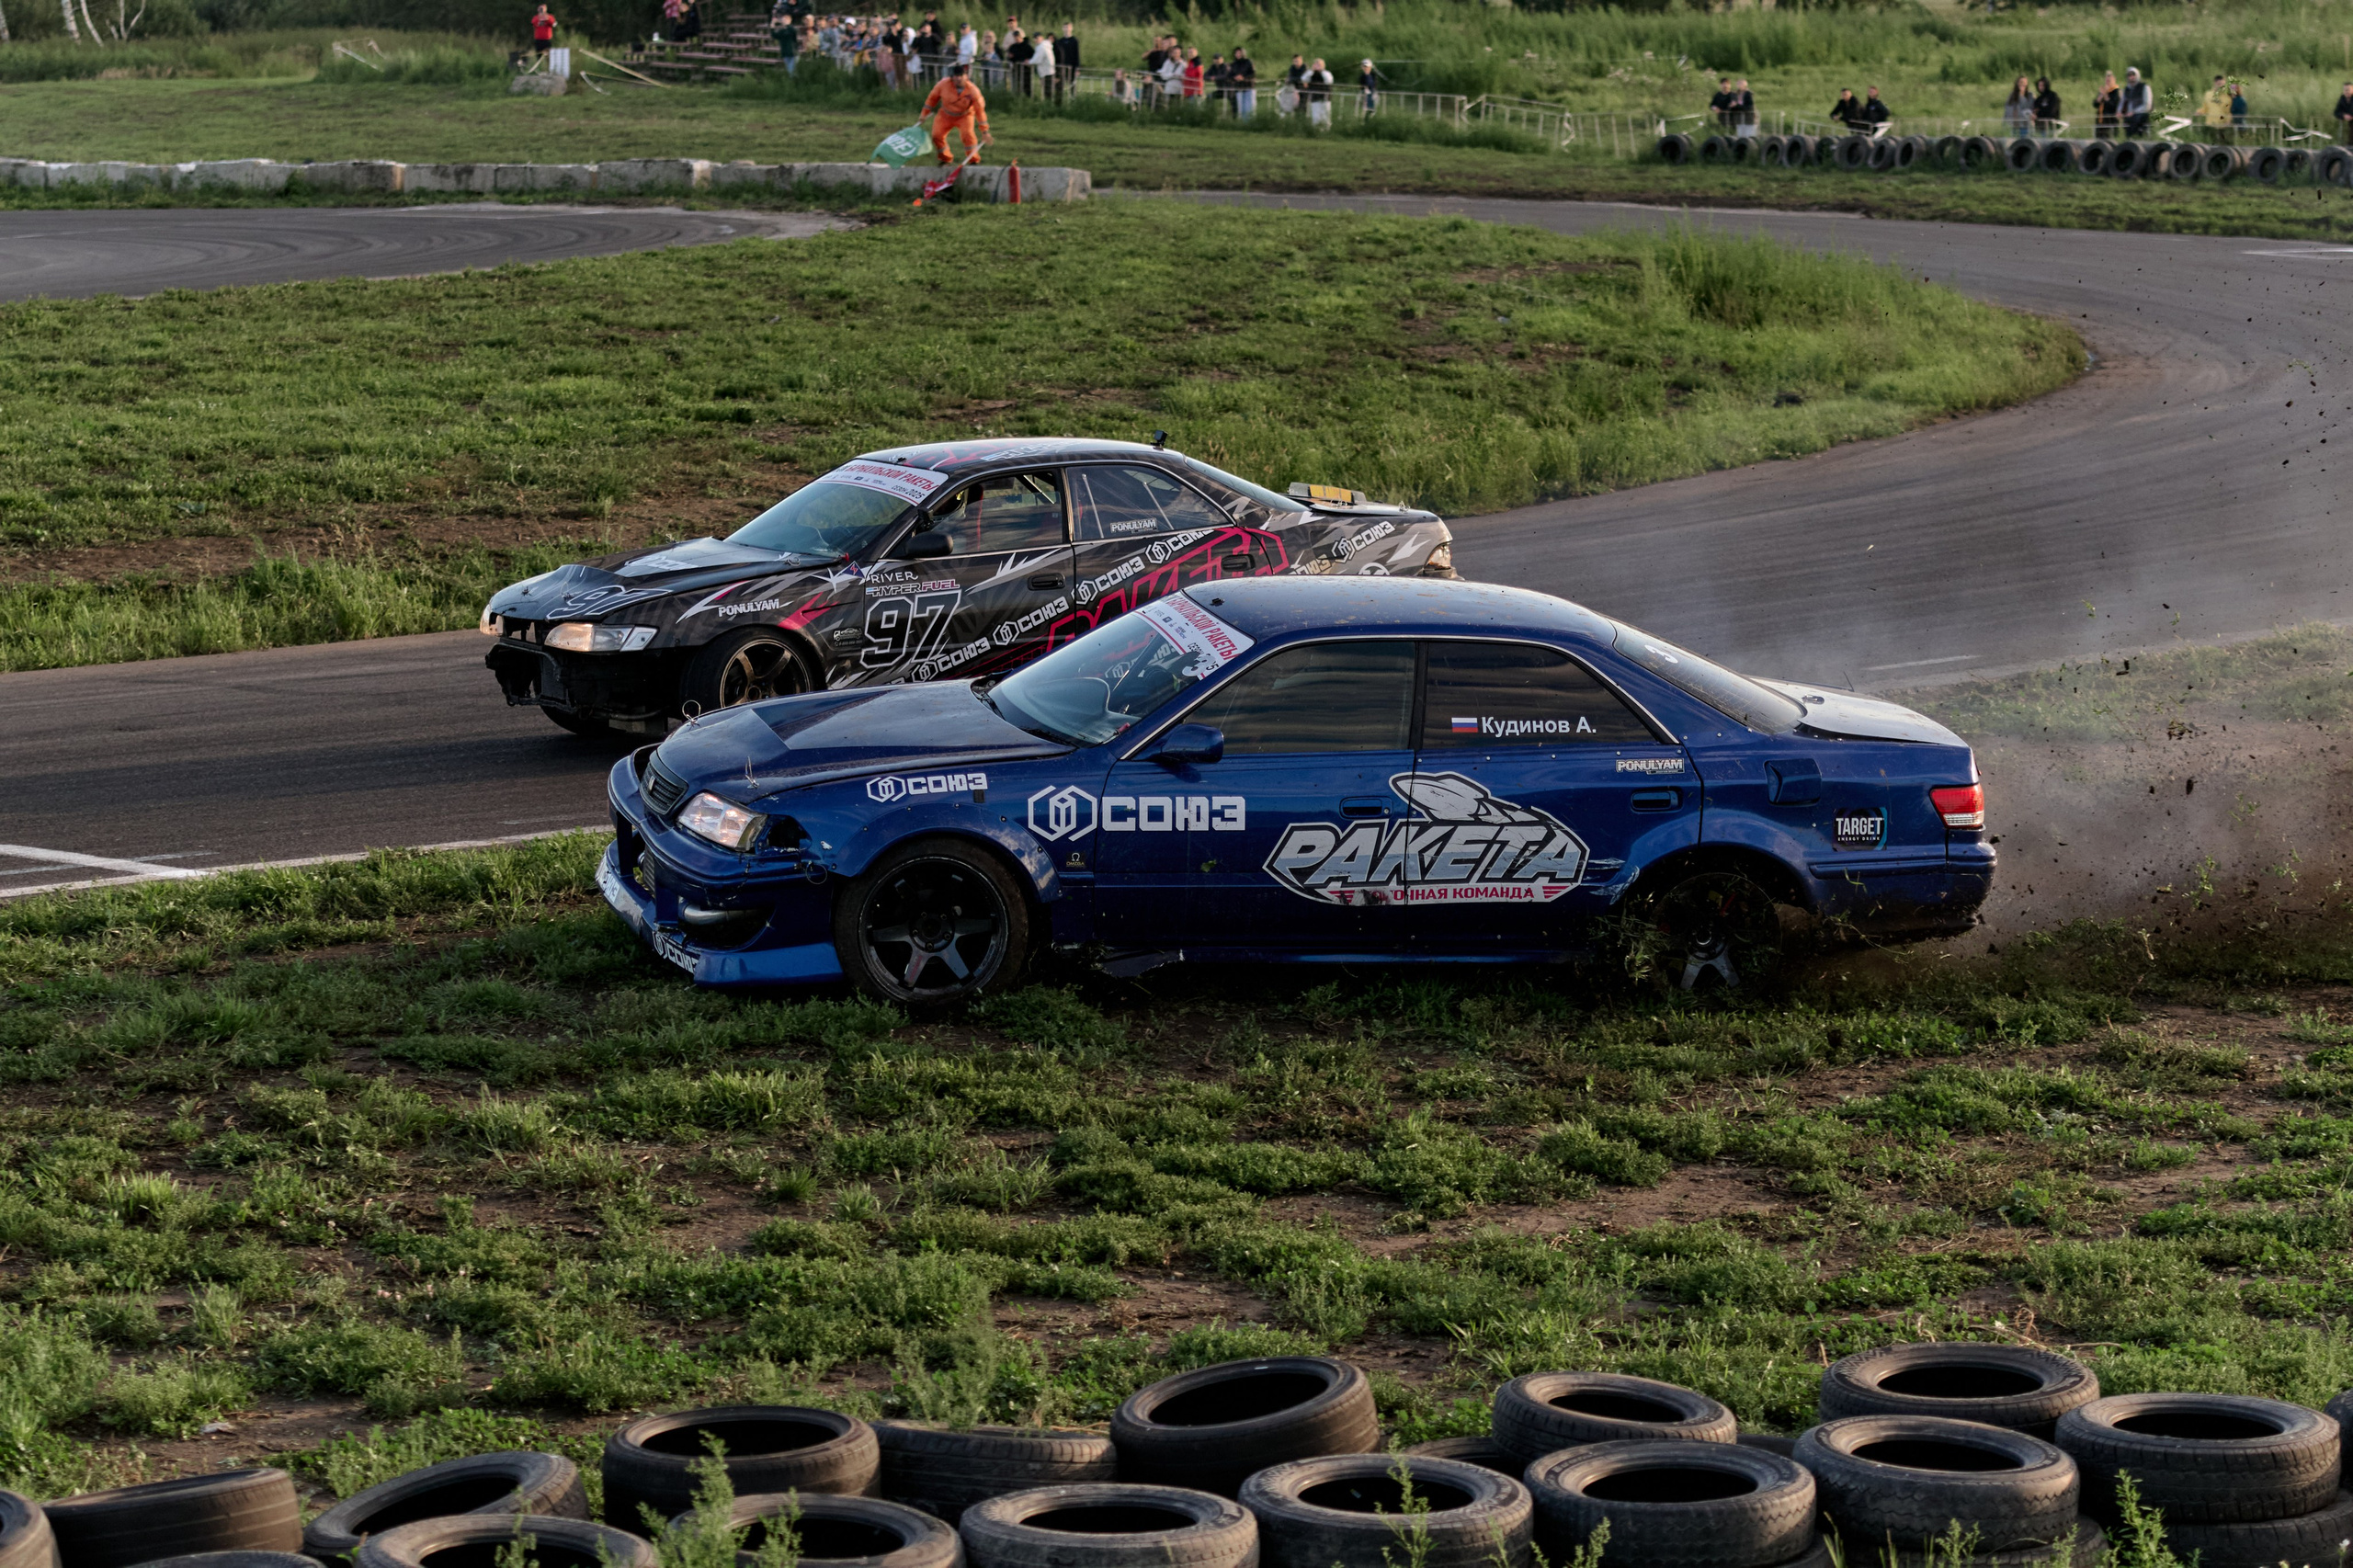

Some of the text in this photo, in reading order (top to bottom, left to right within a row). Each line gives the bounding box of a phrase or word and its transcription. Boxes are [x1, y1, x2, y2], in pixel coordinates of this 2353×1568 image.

[901, 472, 940, 492] РАКЕТЫ
[904, 488, 926, 499] 2025
[1111, 519, 1157, 532] PONULYAM
[1353, 520, 1396, 551] СОЮЗ
[1094, 556, 1145, 592] СОЮЗ
[1288, 553, 1332, 575] ОЮЗ
[870, 571, 919, 584] RIVER
[546, 585, 674, 620] 97
[718, 598, 779, 618] PONULYAM
[1017, 596, 1070, 633] СОЮЗ
[859, 589, 962, 669] 97
[937, 636, 991, 673] СОЮЗ
[1202, 626, 1242, 661] РАКЕТЫ
[1481, 716, 1597, 738] Кудинов А.
[1618, 759, 1683, 771] PONULYAM
[907, 772, 988, 796] СОЮЗ
[1102, 796, 1246, 832] СОЮЗ
[1836, 817, 1883, 835] TARGET
[1270, 824, 1585, 885] РАКЕТА
[1452, 886, 1535, 900] КОМАНДА
